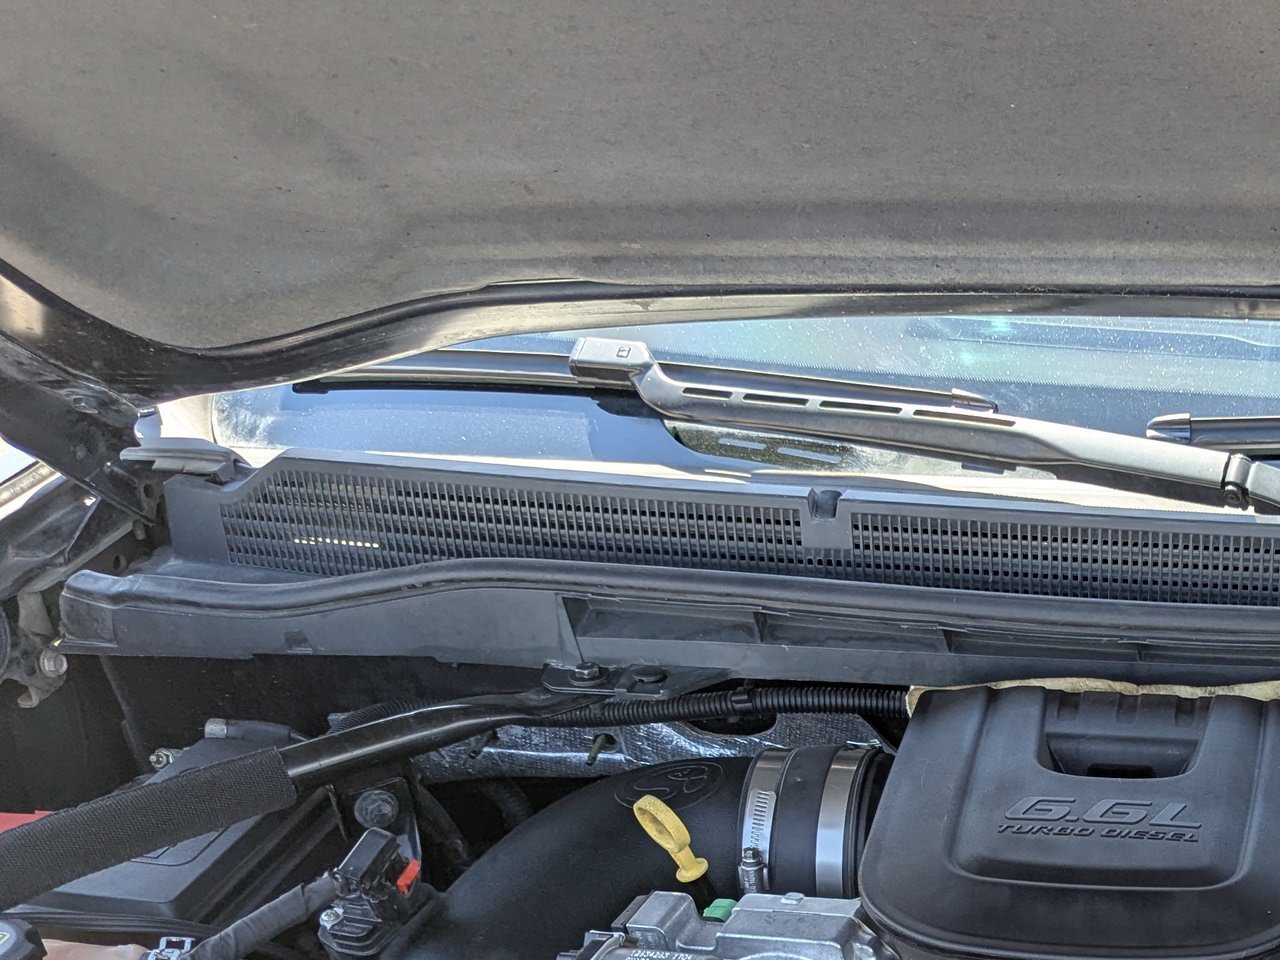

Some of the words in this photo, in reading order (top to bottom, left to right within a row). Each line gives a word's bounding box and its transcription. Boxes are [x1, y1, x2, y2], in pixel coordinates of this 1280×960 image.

[1005, 797, 1202, 829] 6.6L
[998, 824, 1096, 837] TURBO
[1100, 828, 1199, 843] DIESEL
